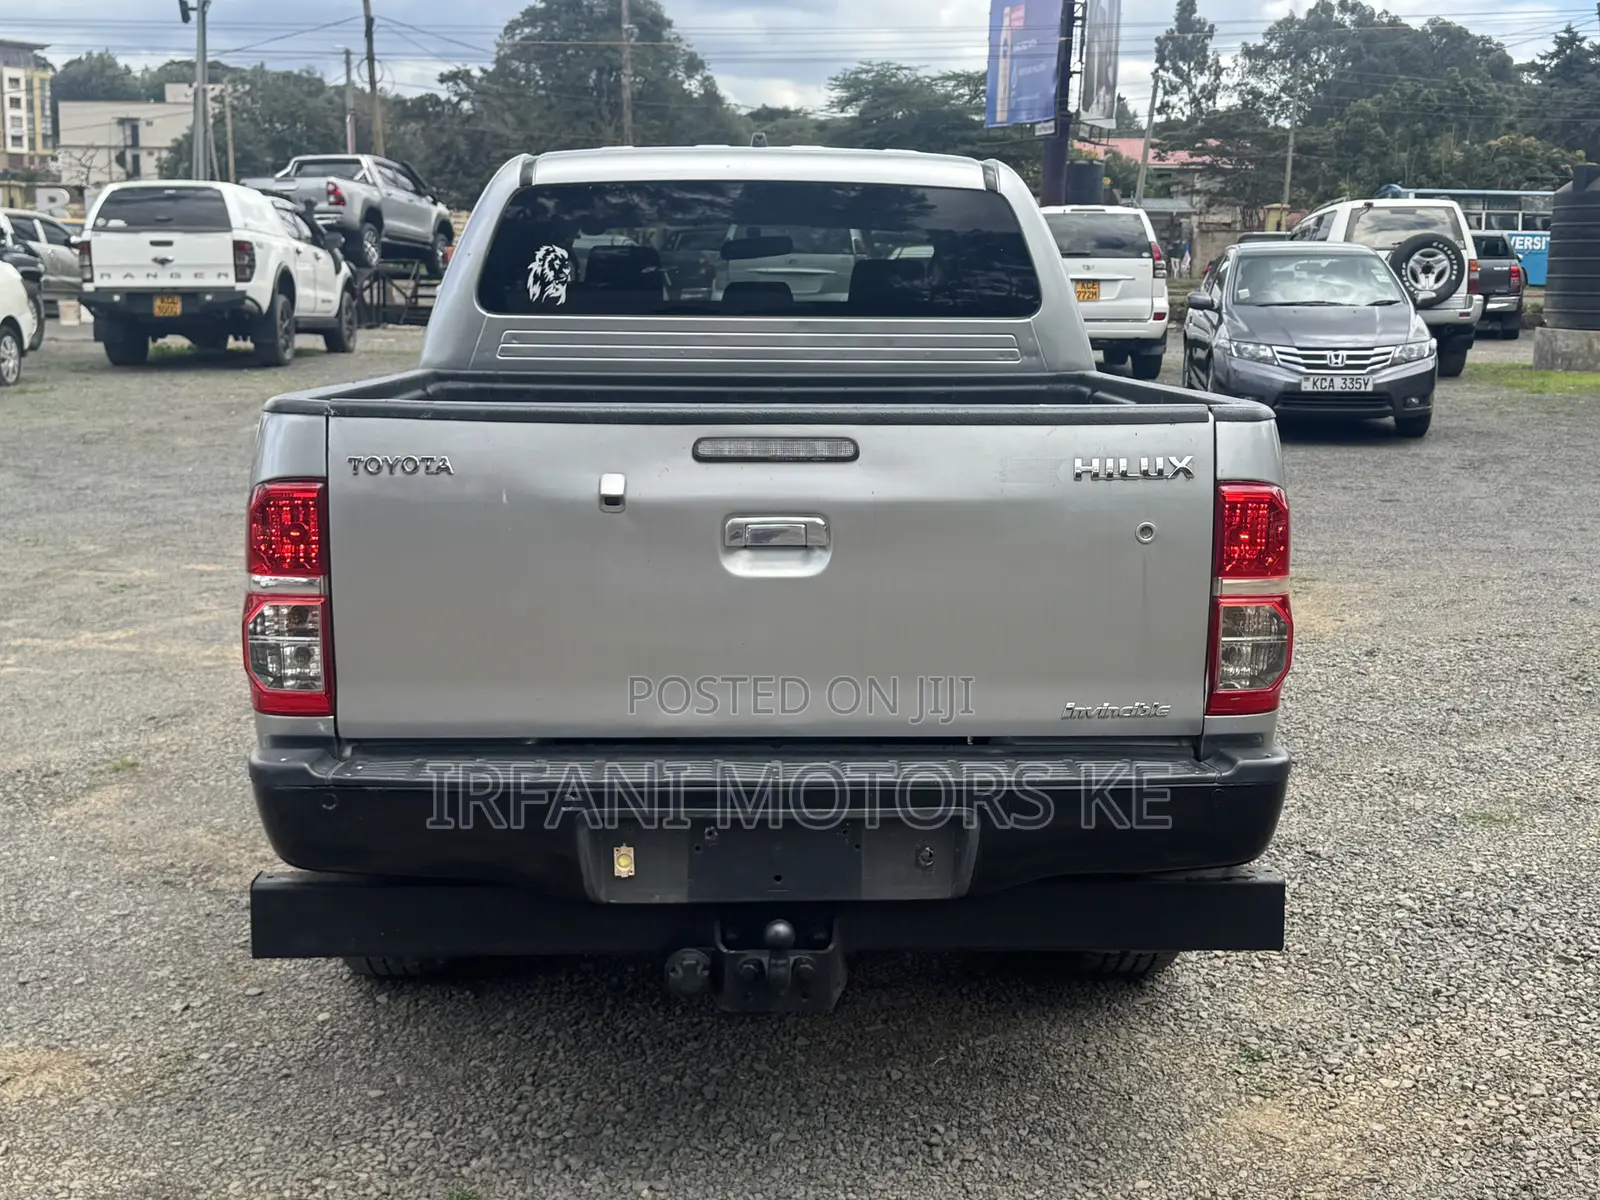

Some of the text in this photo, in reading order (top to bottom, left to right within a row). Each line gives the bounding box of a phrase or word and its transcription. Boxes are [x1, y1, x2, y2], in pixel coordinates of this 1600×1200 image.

[100, 272, 230, 280] RANGER
[1312, 377, 1370, 390] KCA 335Y
[347, 455, 454, 476] TOYOTA
[1073, 454, 1195, 481] HILUX
